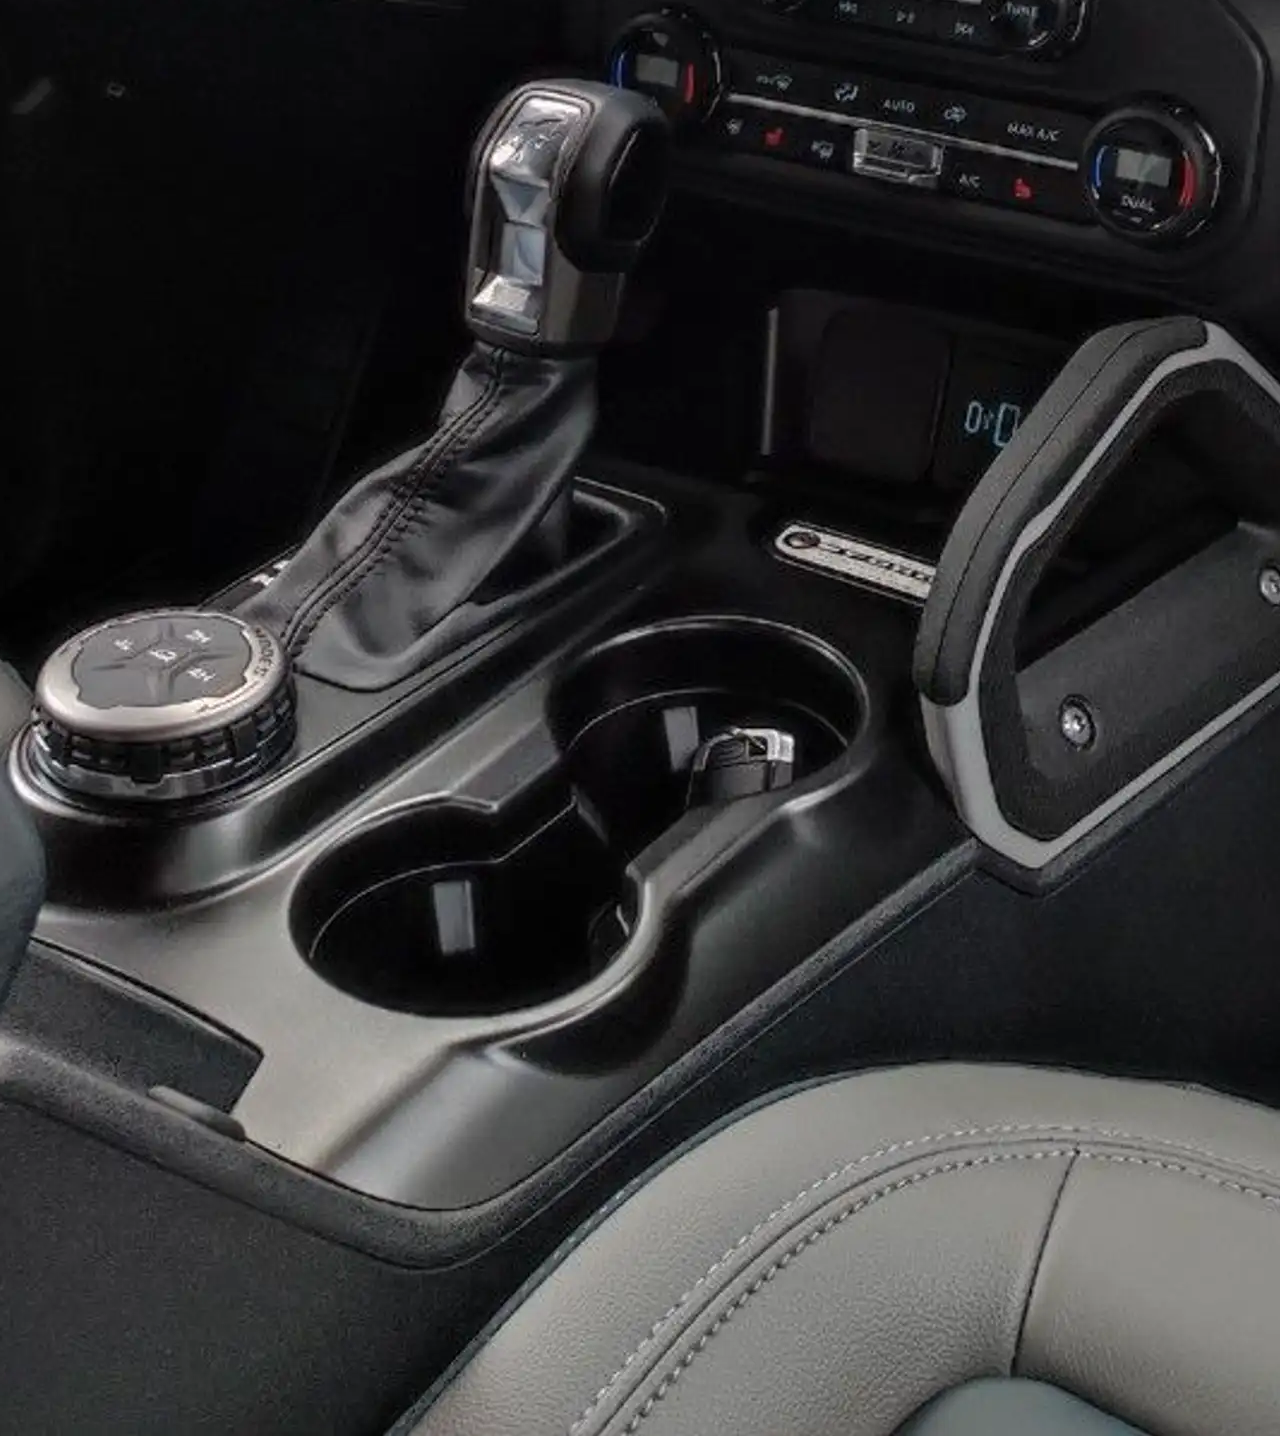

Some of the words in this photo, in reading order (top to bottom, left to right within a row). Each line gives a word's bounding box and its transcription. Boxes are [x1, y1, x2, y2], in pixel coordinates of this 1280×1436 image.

[882, 98, 915, 114] AUTO
[1006, 122, 1035, 140] MAX
[1120, 194, 1155, 213] DUAL
